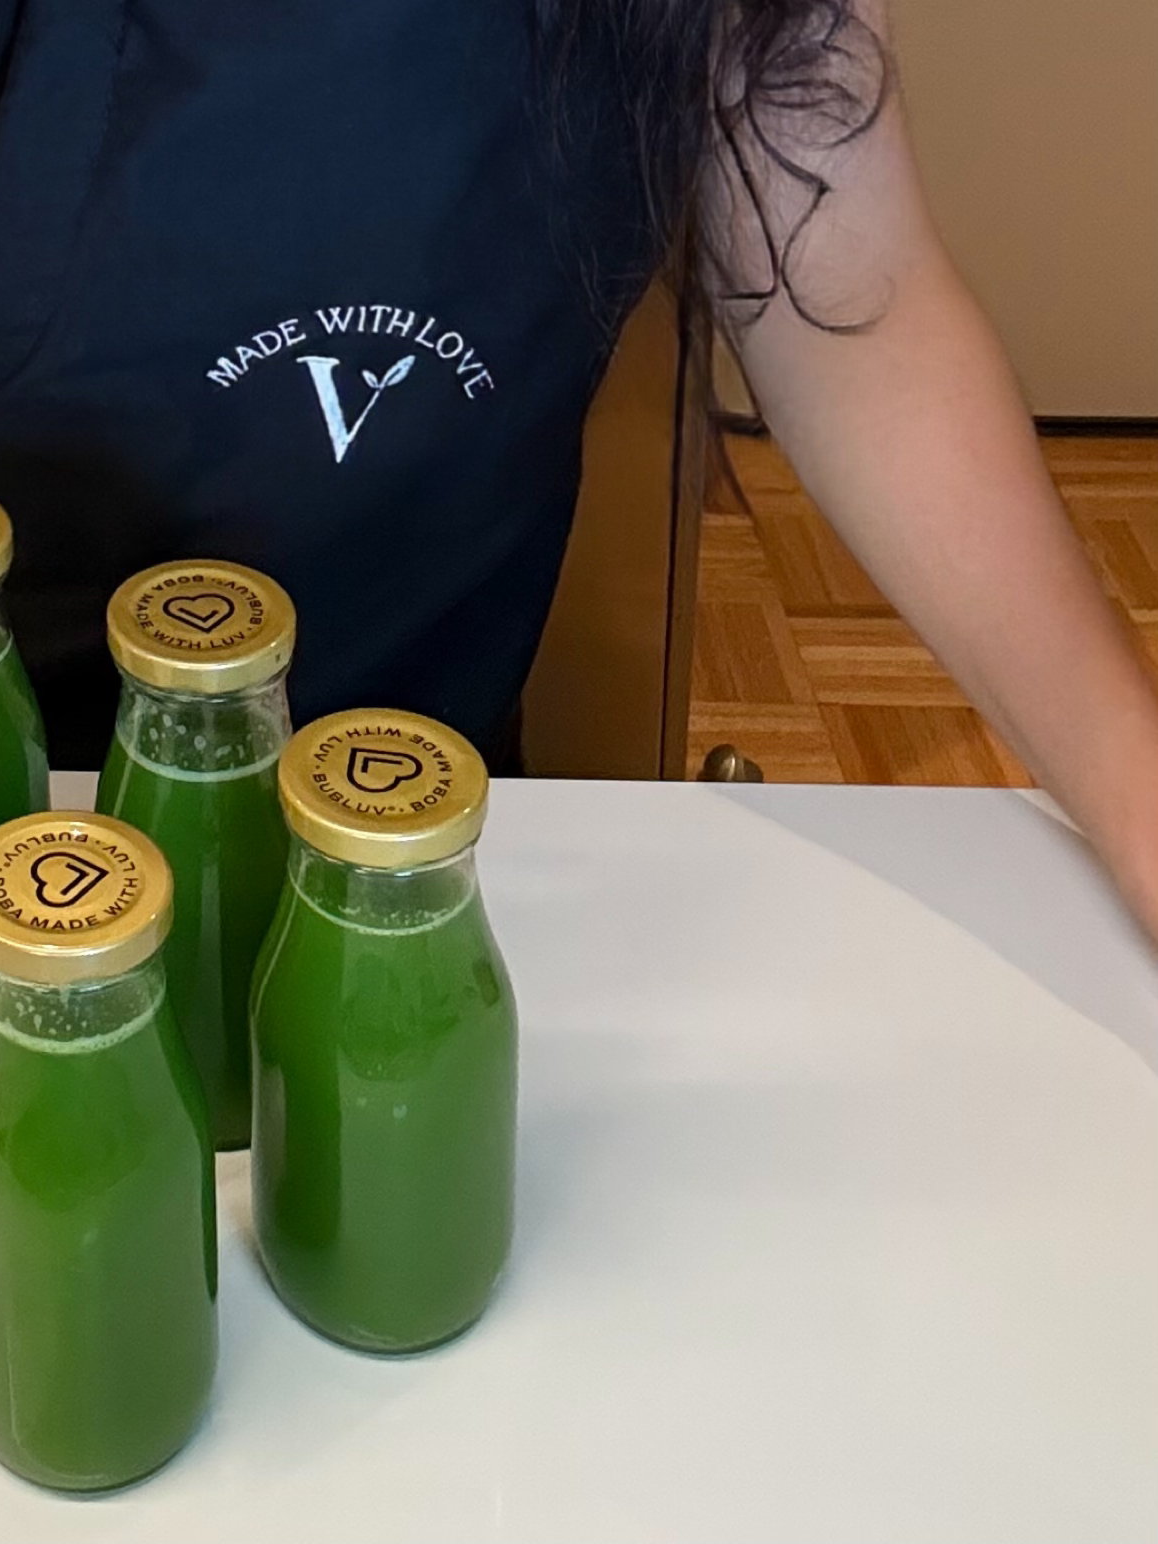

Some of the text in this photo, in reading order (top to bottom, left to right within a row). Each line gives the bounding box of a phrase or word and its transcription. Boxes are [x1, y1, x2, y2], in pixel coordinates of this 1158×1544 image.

[206, 305, 494, 399] MADE WITH LOVE
[136, 574, 246, 650] BOBA MADE WITH LUV
[313, 725, 454, 813] BOBA MADE WITH LUV
[103, 844, 136, 872] LUV
[29, 914, 101, 931] MADE
[103, 876, 139, 917] WITH
